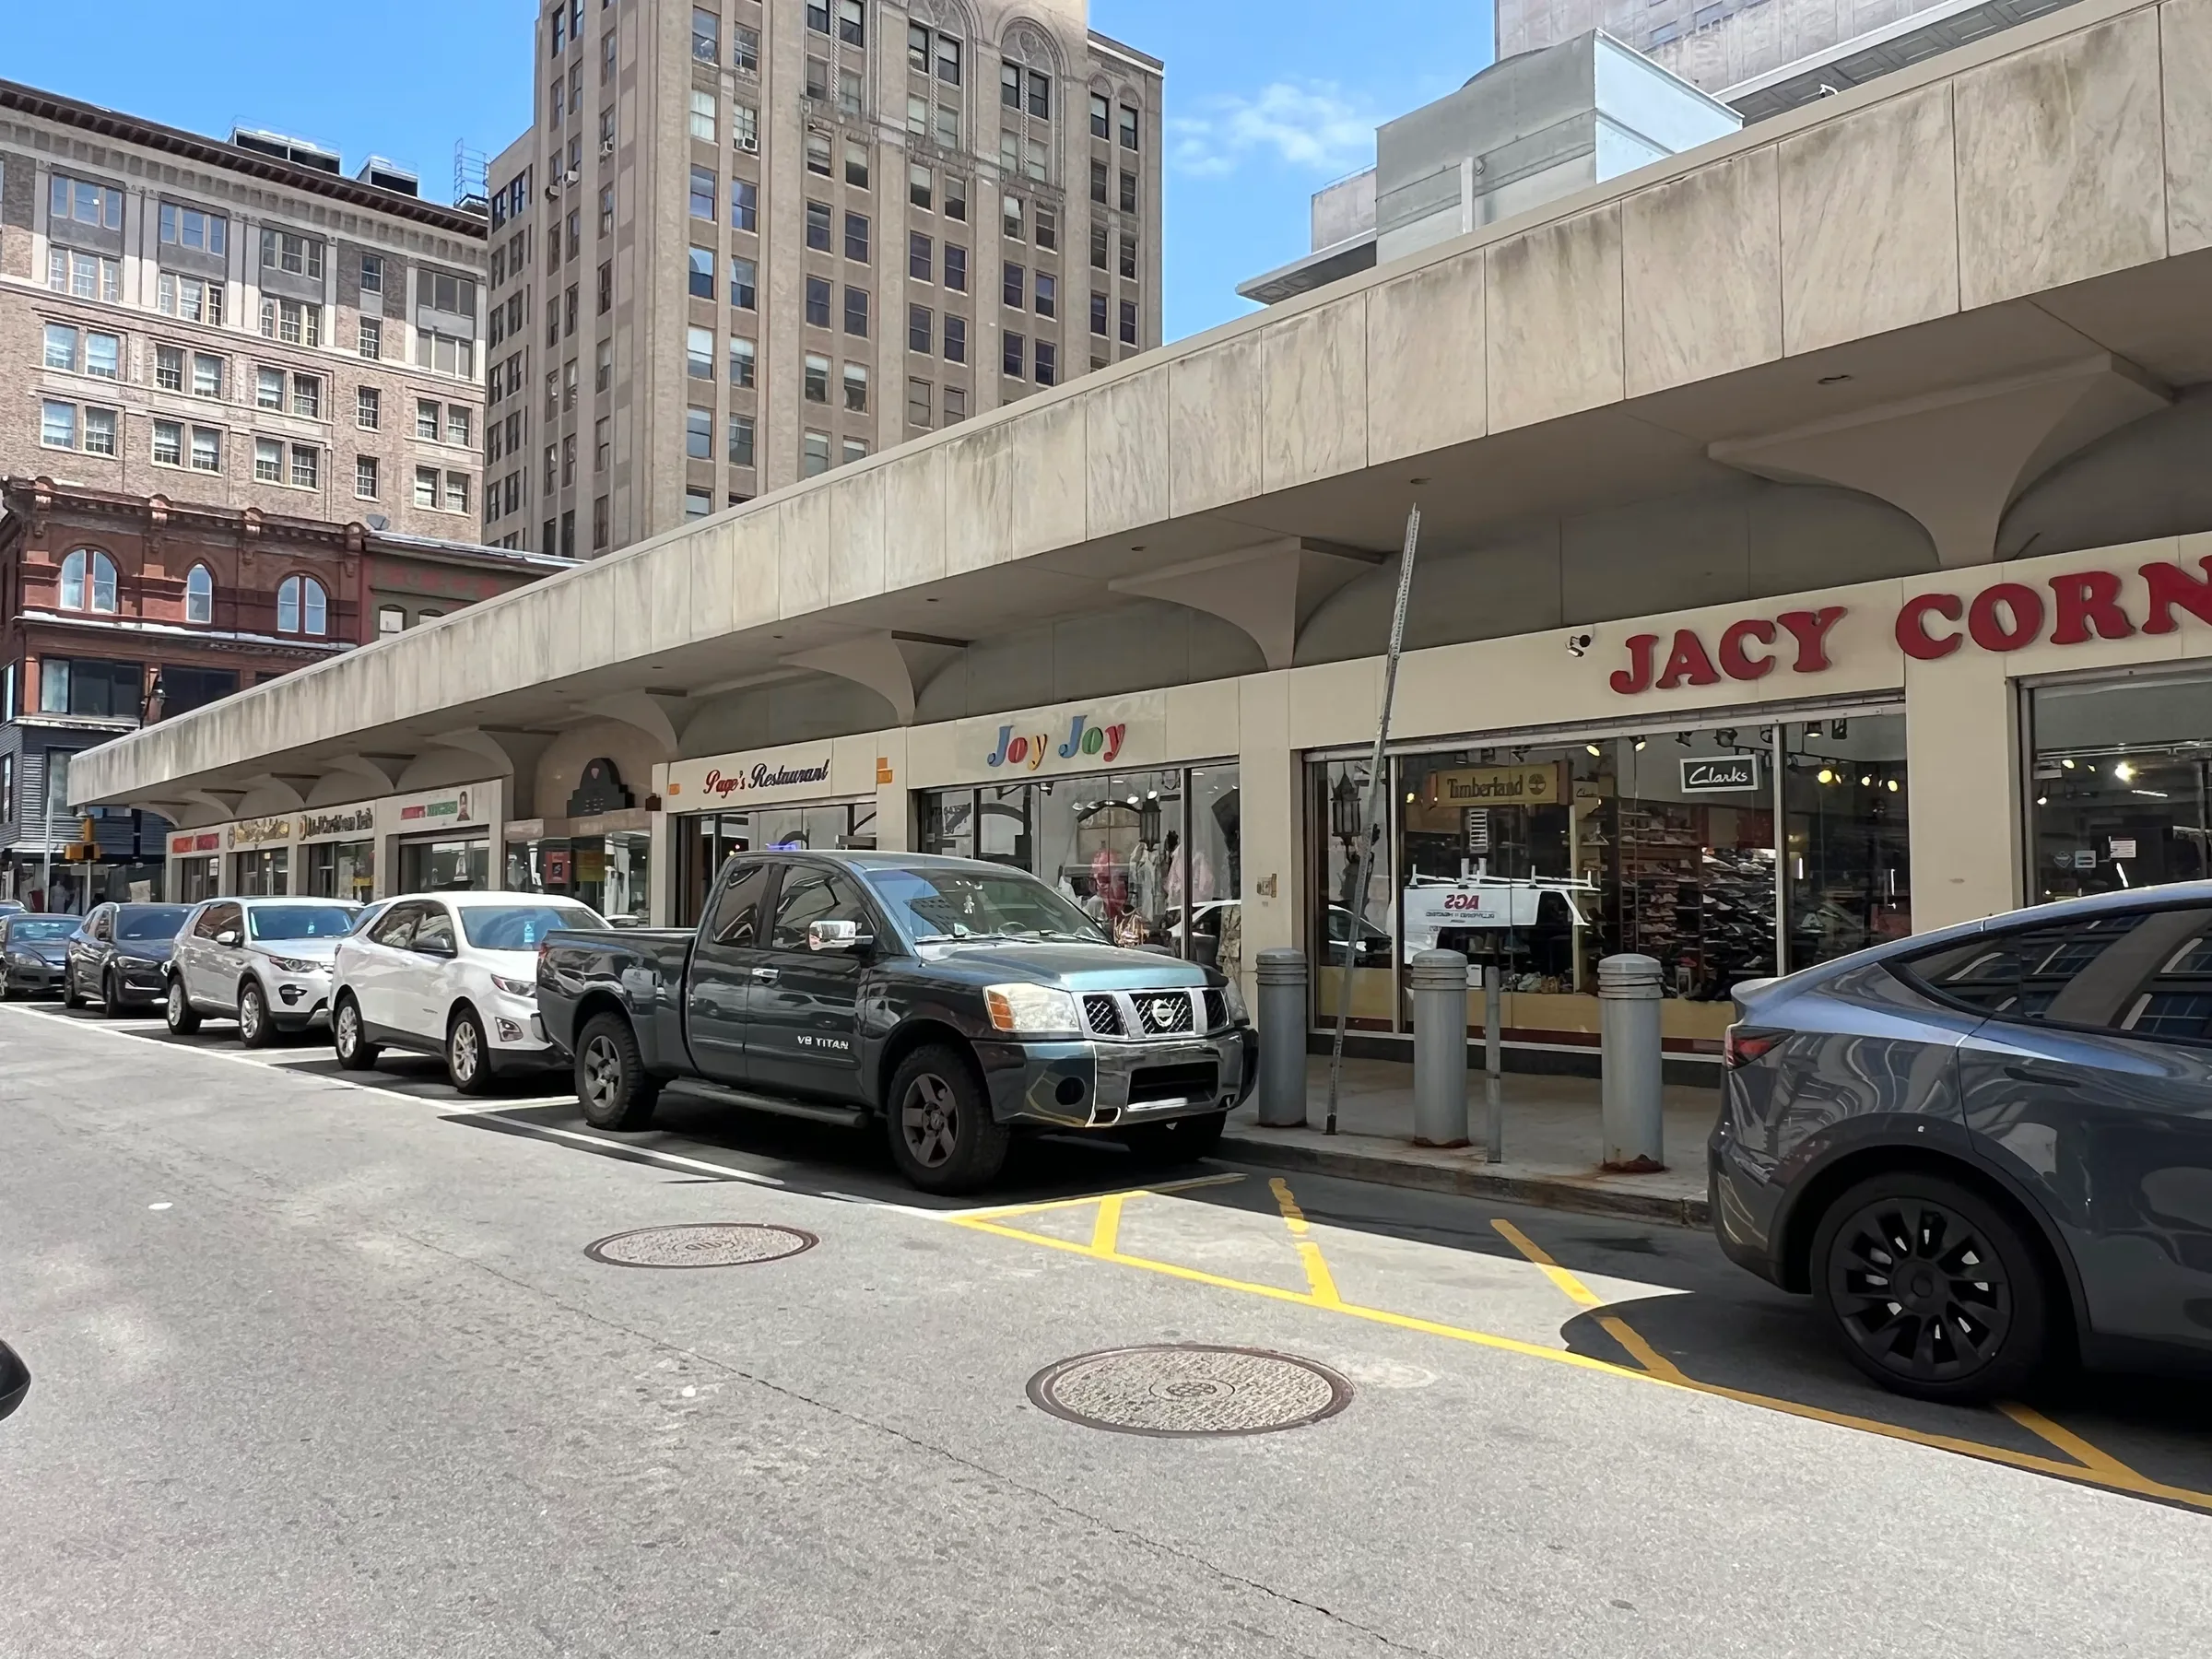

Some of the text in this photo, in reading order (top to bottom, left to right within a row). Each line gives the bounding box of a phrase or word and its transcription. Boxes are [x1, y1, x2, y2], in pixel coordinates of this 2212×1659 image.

[1609, 555, 2212, 694] JACY CORN
[987, 714, 1125, 771] Joy Joy
[703, 759, 830, 799] Page's Restaurant
[1447, 775, 1524, 799] Timberland
[1688, 765, 1748, 785] Clarks
[797, 1035, 849, 1050] V8 TITAN
